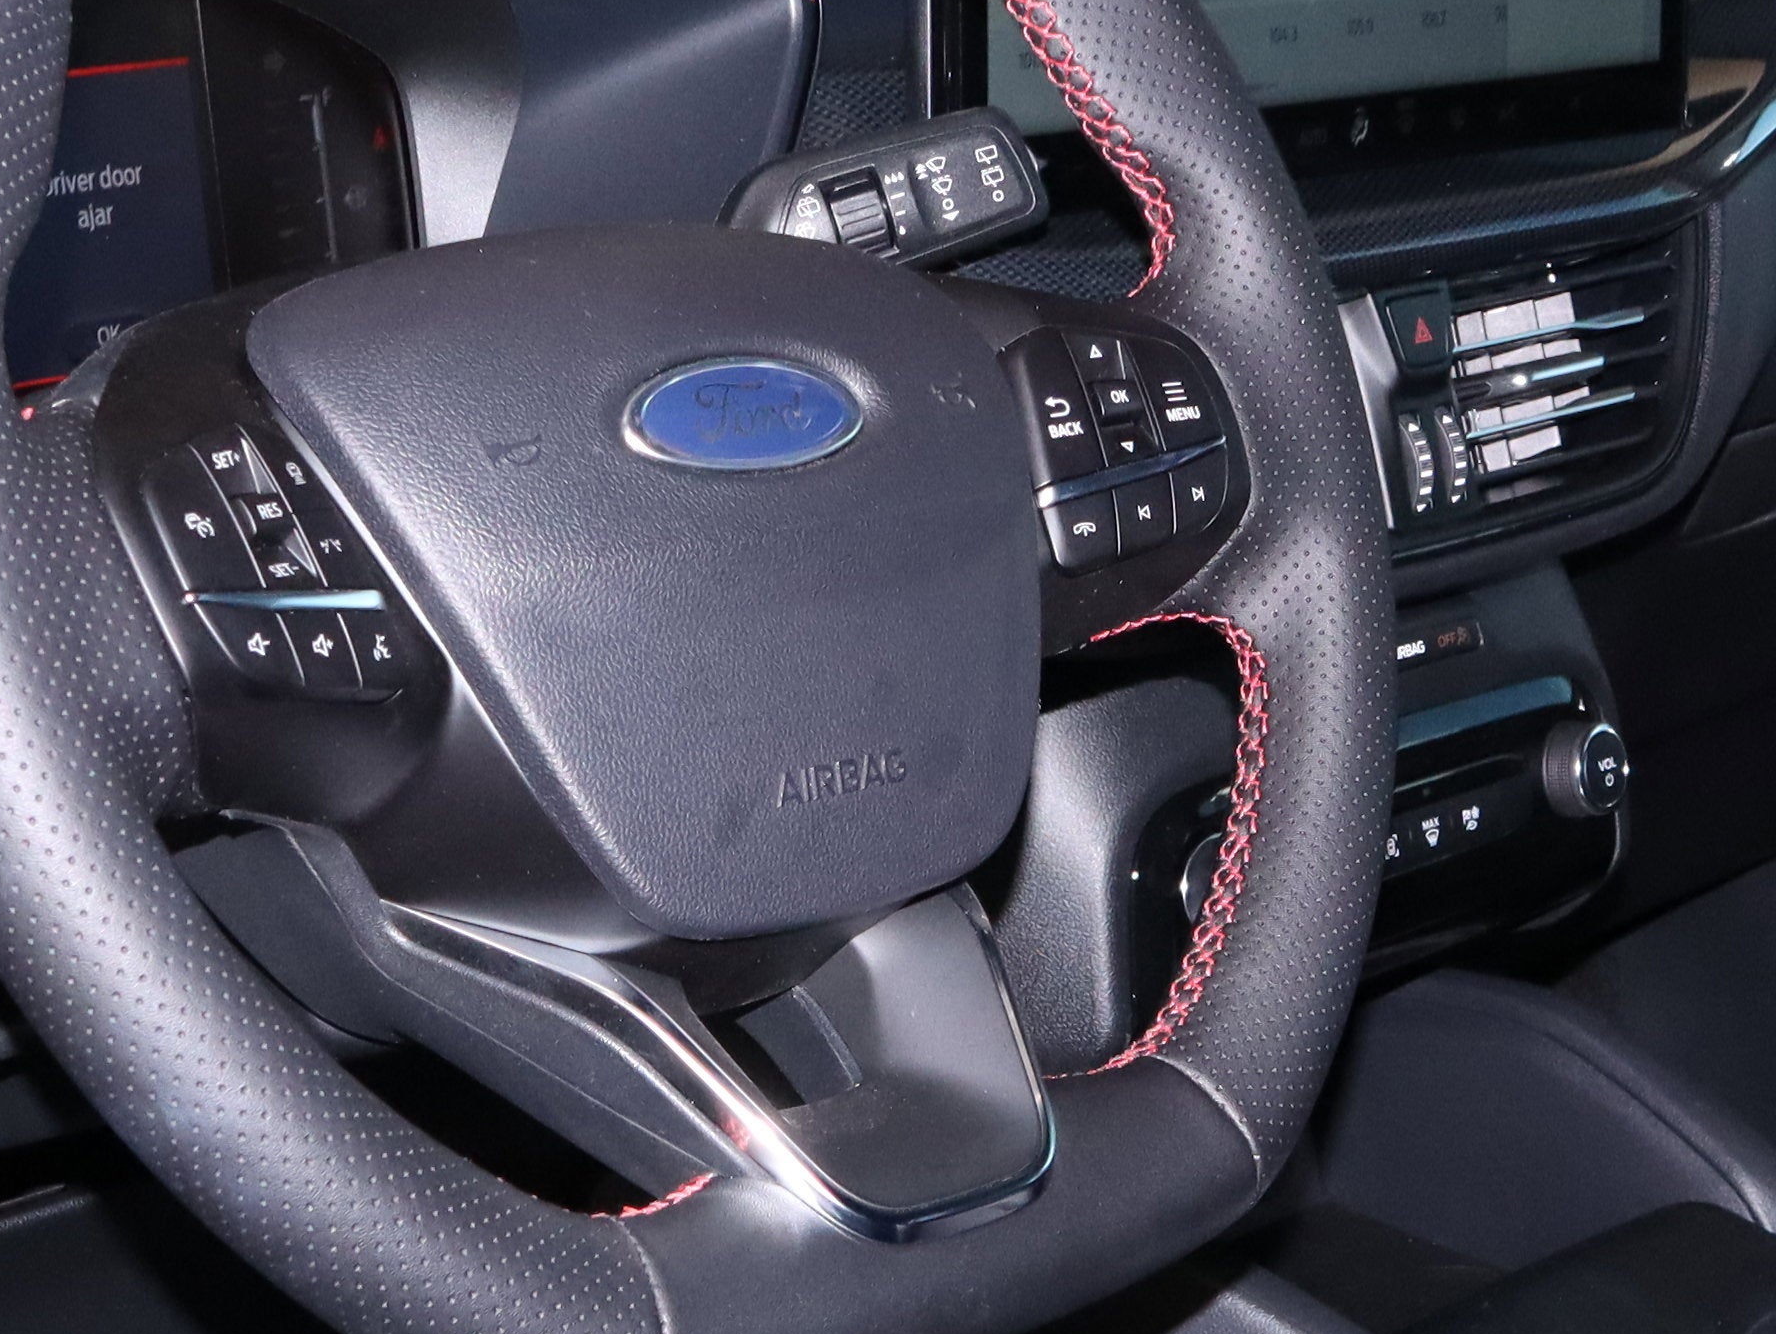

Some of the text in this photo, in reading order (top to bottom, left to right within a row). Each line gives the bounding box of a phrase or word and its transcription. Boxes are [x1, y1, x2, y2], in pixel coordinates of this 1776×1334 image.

[99, 162, 142, 189] door
[77, 203, 113, 232] ajar
[1110, 389, 1130, 404] OK
[1165, 405, 1201, 423] MENU
[1047, 420, 1084, 439] BACK
[211, 450, 241, 470] SET+
[255, 502, 284, 520] RES
[268, 562, 300, 578] SET-
[1598, 757, 1617, 772] VOL
[776, 749, 907, 809] AIRBAG
[1422, 817, 1439, 830] MAX
